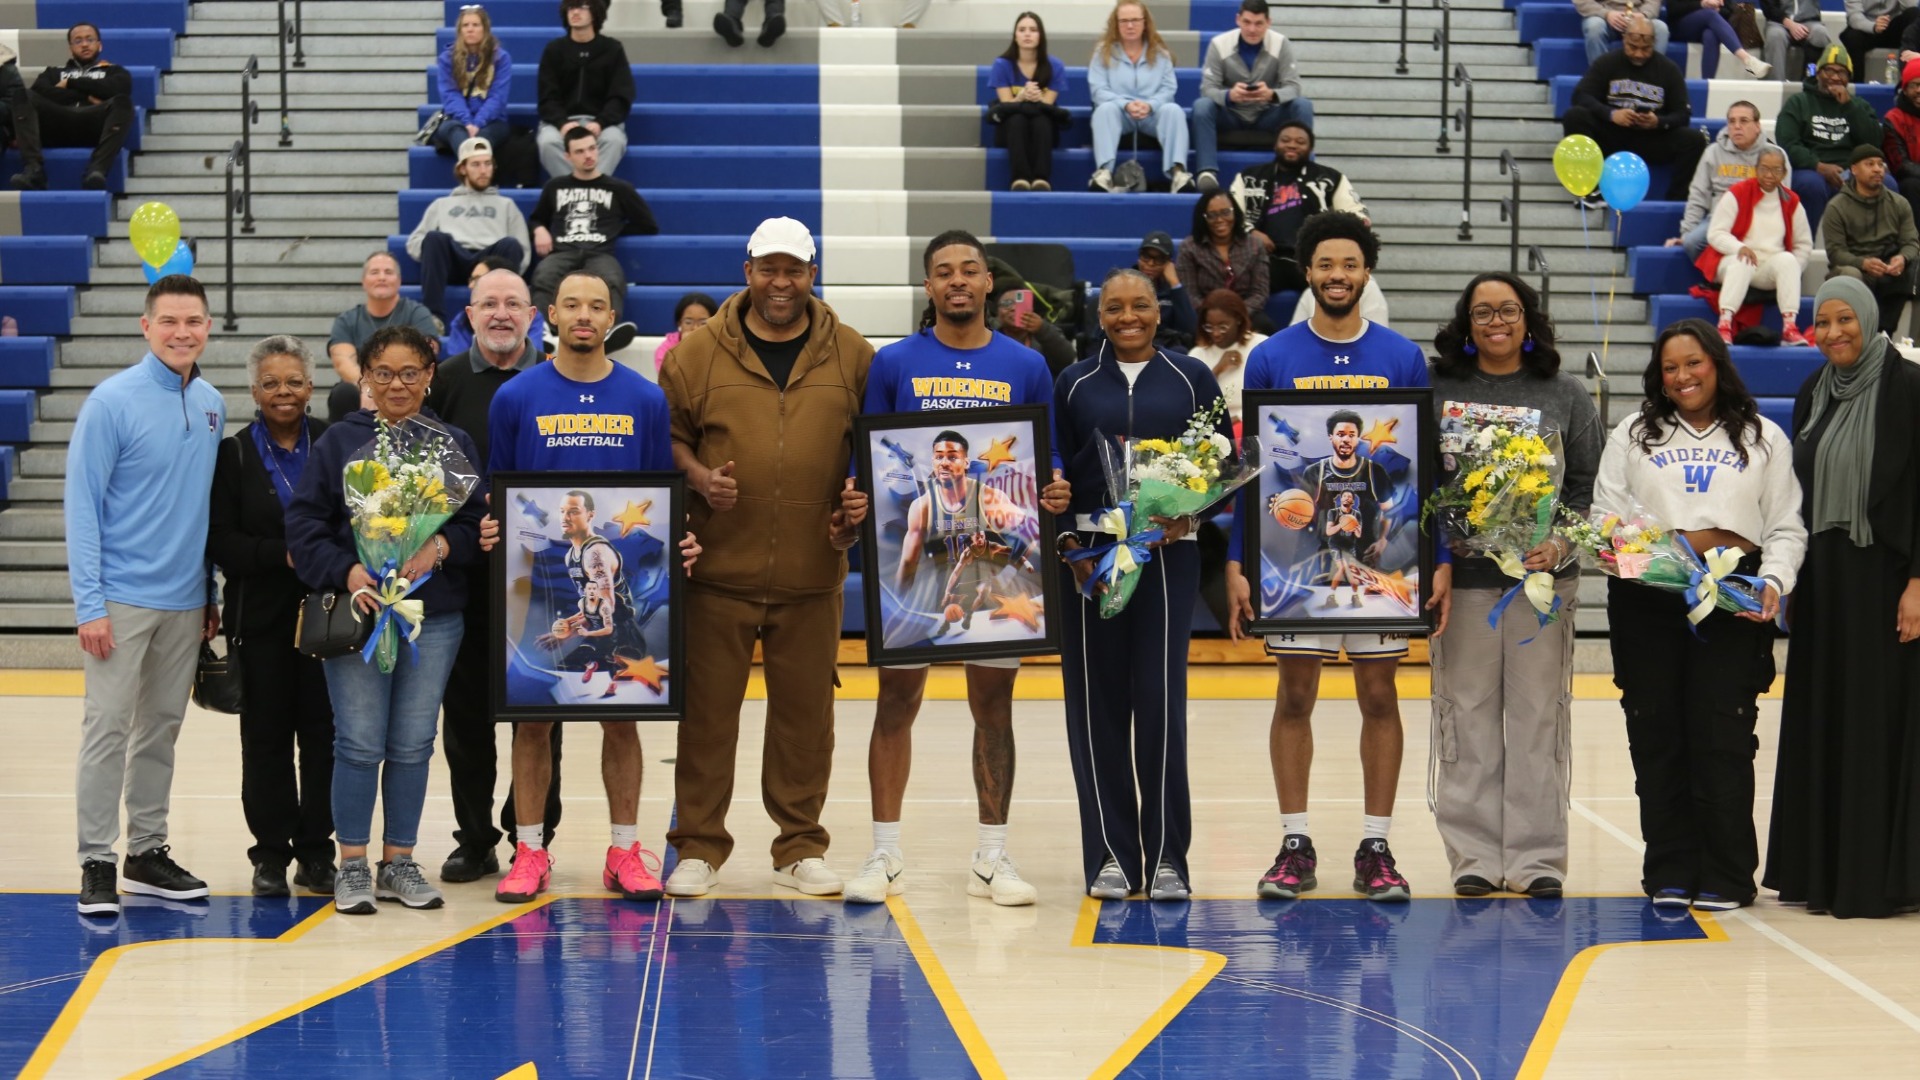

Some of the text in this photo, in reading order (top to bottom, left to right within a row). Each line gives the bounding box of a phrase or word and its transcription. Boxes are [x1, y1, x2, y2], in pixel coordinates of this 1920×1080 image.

[556, 188, 613, 212] DEATH ROW
[911, 377, 1012, 403] WIDENER
[536, 413, 634, 436] WIDENER
[546, 436, 625, 447] BASKETBALL
[1648, 448, 1746, 473] WIDENER
